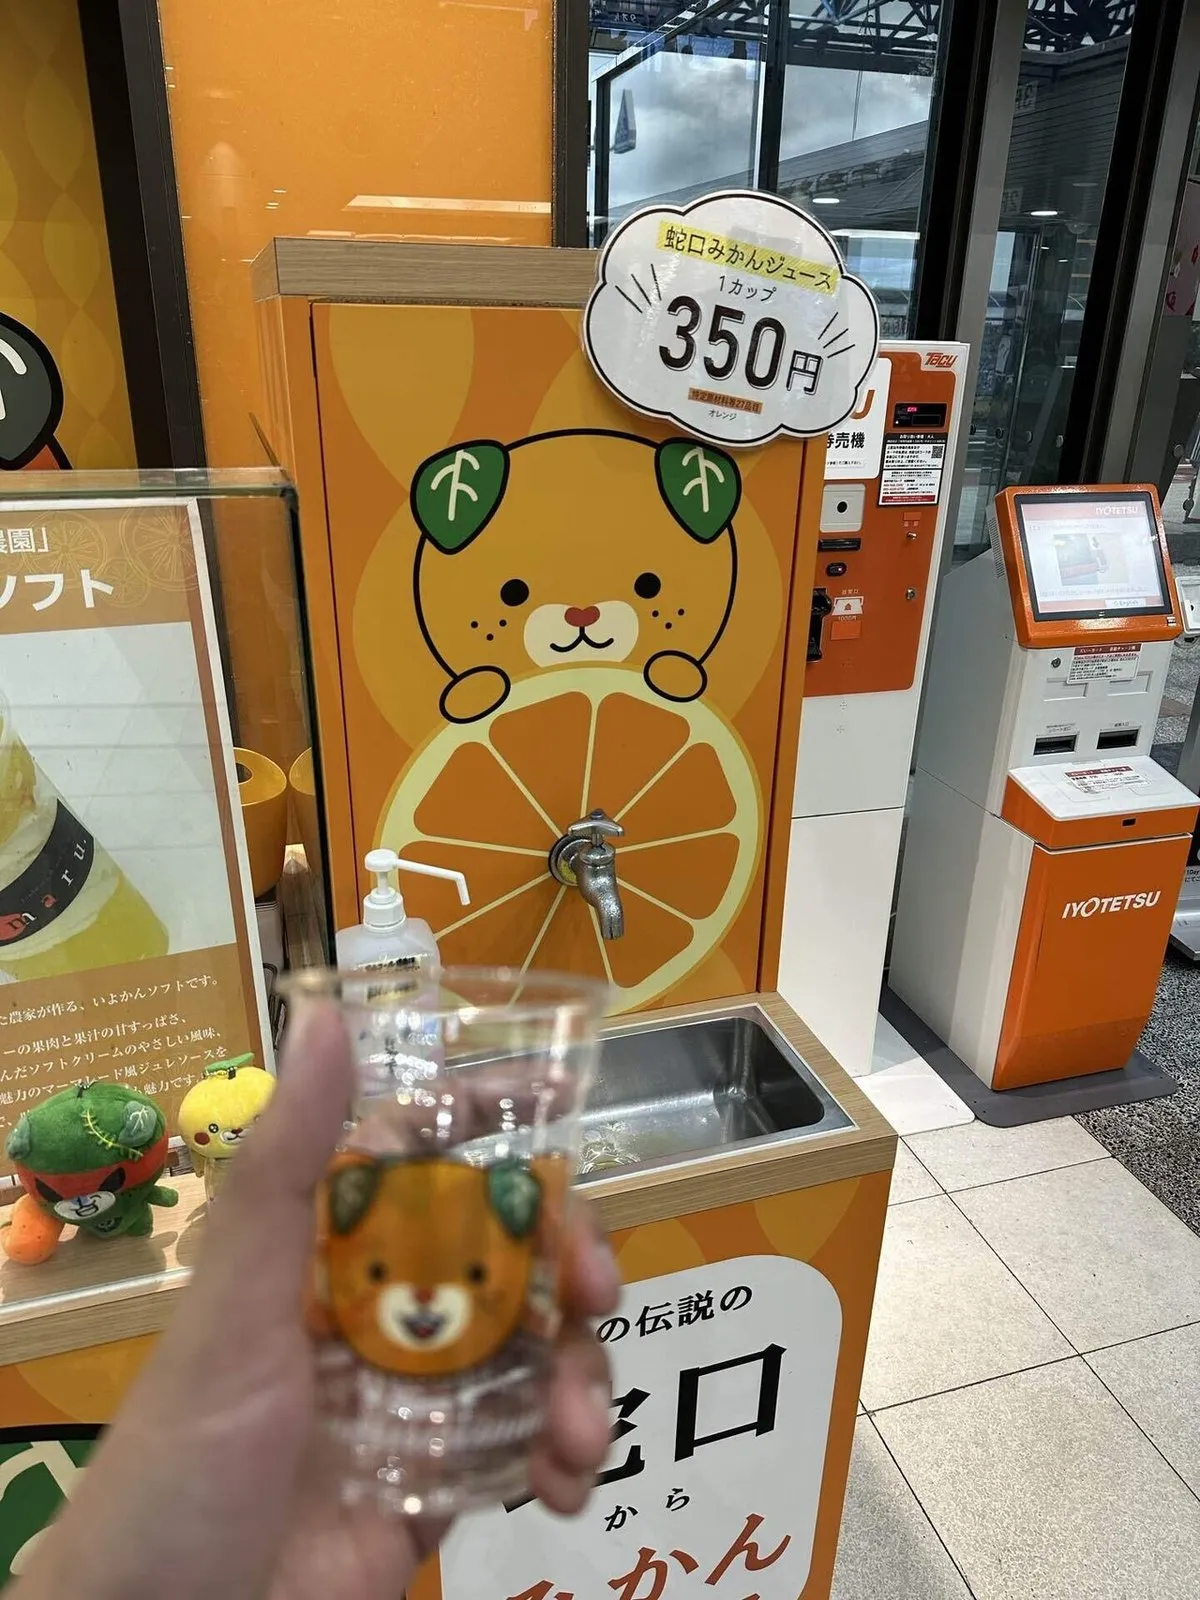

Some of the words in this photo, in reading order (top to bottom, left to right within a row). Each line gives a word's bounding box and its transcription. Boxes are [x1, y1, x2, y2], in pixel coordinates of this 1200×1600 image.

[664, 225, 832, 290] 蛇口みかんジュース
[719, 275, 777, 302] 1カップ
[658, 295, 824, 396] 350円
[708, 409, 738, 421] オレンジ
[1096, 505, 1139, 515] IYOTETSU
[1062, 890, 1161, 919] IYOTETSU
[0, 1027, 221, 1082] んだソフトクリームのやさしい風味、
[604, 1487, 691, 1532] から
[506, 1513, 792, 1600] かん
